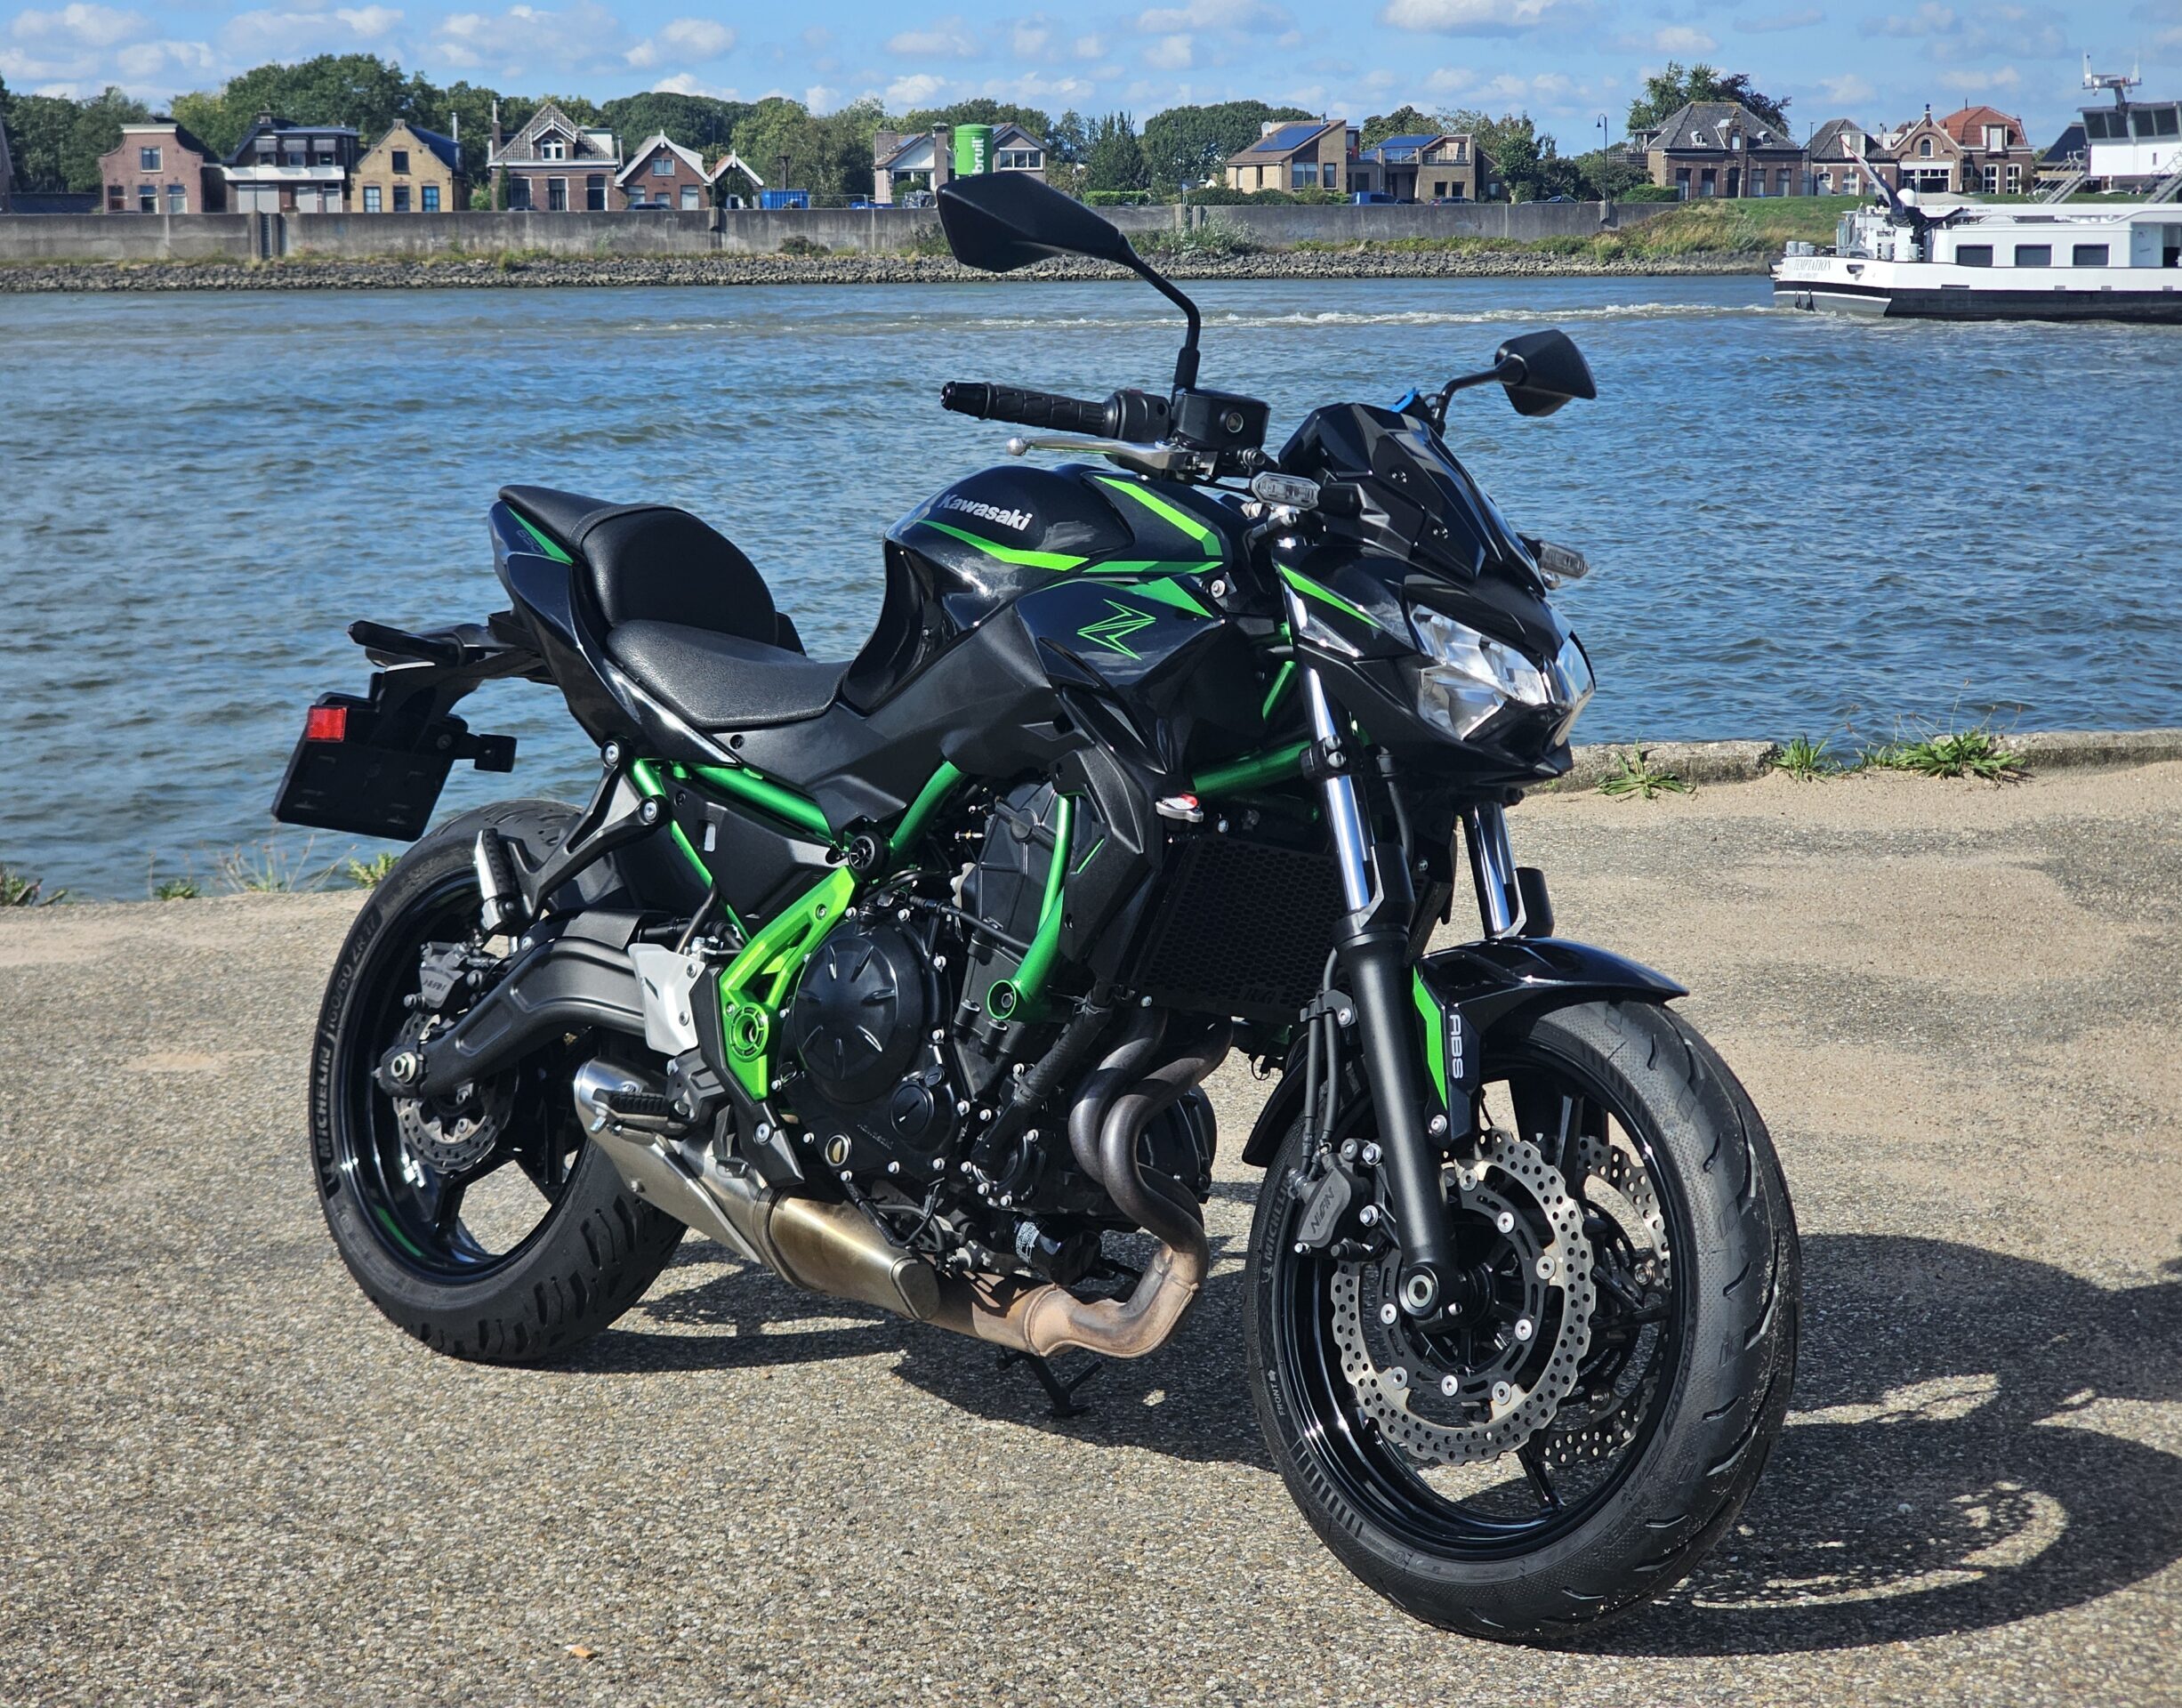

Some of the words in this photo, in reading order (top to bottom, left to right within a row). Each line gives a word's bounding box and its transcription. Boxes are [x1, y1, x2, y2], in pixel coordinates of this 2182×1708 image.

[971, 136, 985, 175] bruil
[1793, 258, 1832, 271] TEMPTATION
[937, 494, 1034, 531] Kawasaki
[1449, 1014, 1464, 1079] ABS
[317, 1045, 332, 1158] MICHELIN
[1270, 1382, 1286, 1416] FRONT
